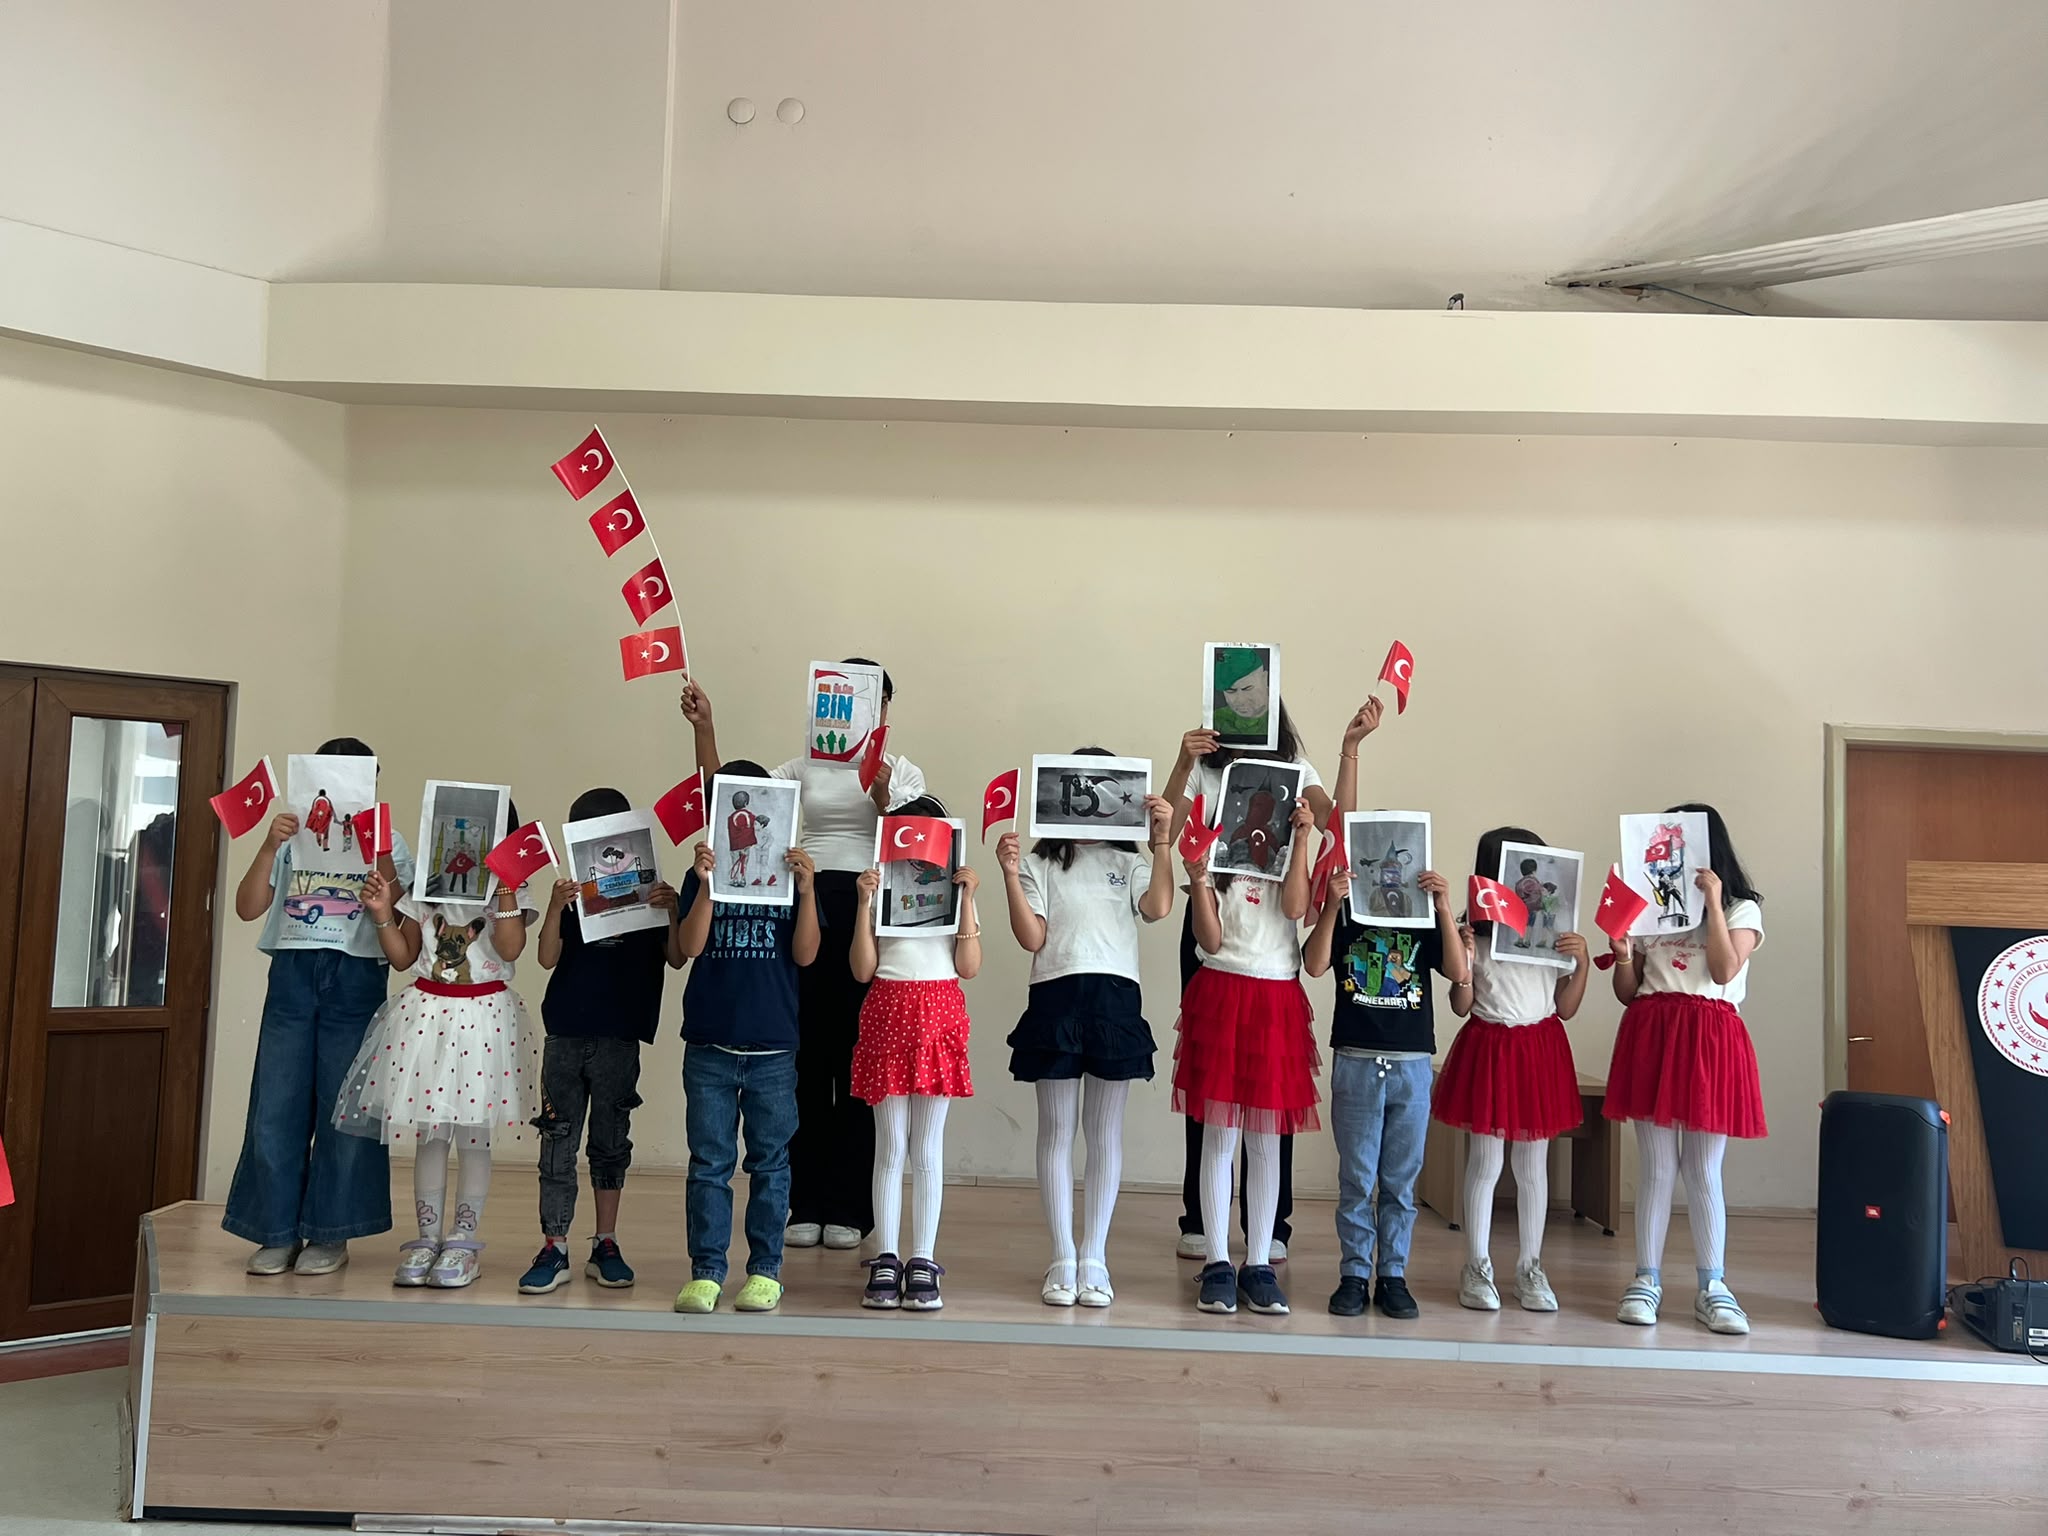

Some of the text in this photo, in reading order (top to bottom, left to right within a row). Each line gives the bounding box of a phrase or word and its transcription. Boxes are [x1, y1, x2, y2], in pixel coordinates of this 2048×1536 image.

[815, 693, 853, 722] BİN
[1060, 774, 1100, 817] 15
[604, 879, 633, 890] TEMMUZ
[713, 903, 791, 919] UMMER
[714, 919, 776, 948] VIBES
[481, 960, 502, 973] Day
[1352, 992, 1408, 1010] MINECRAFT
